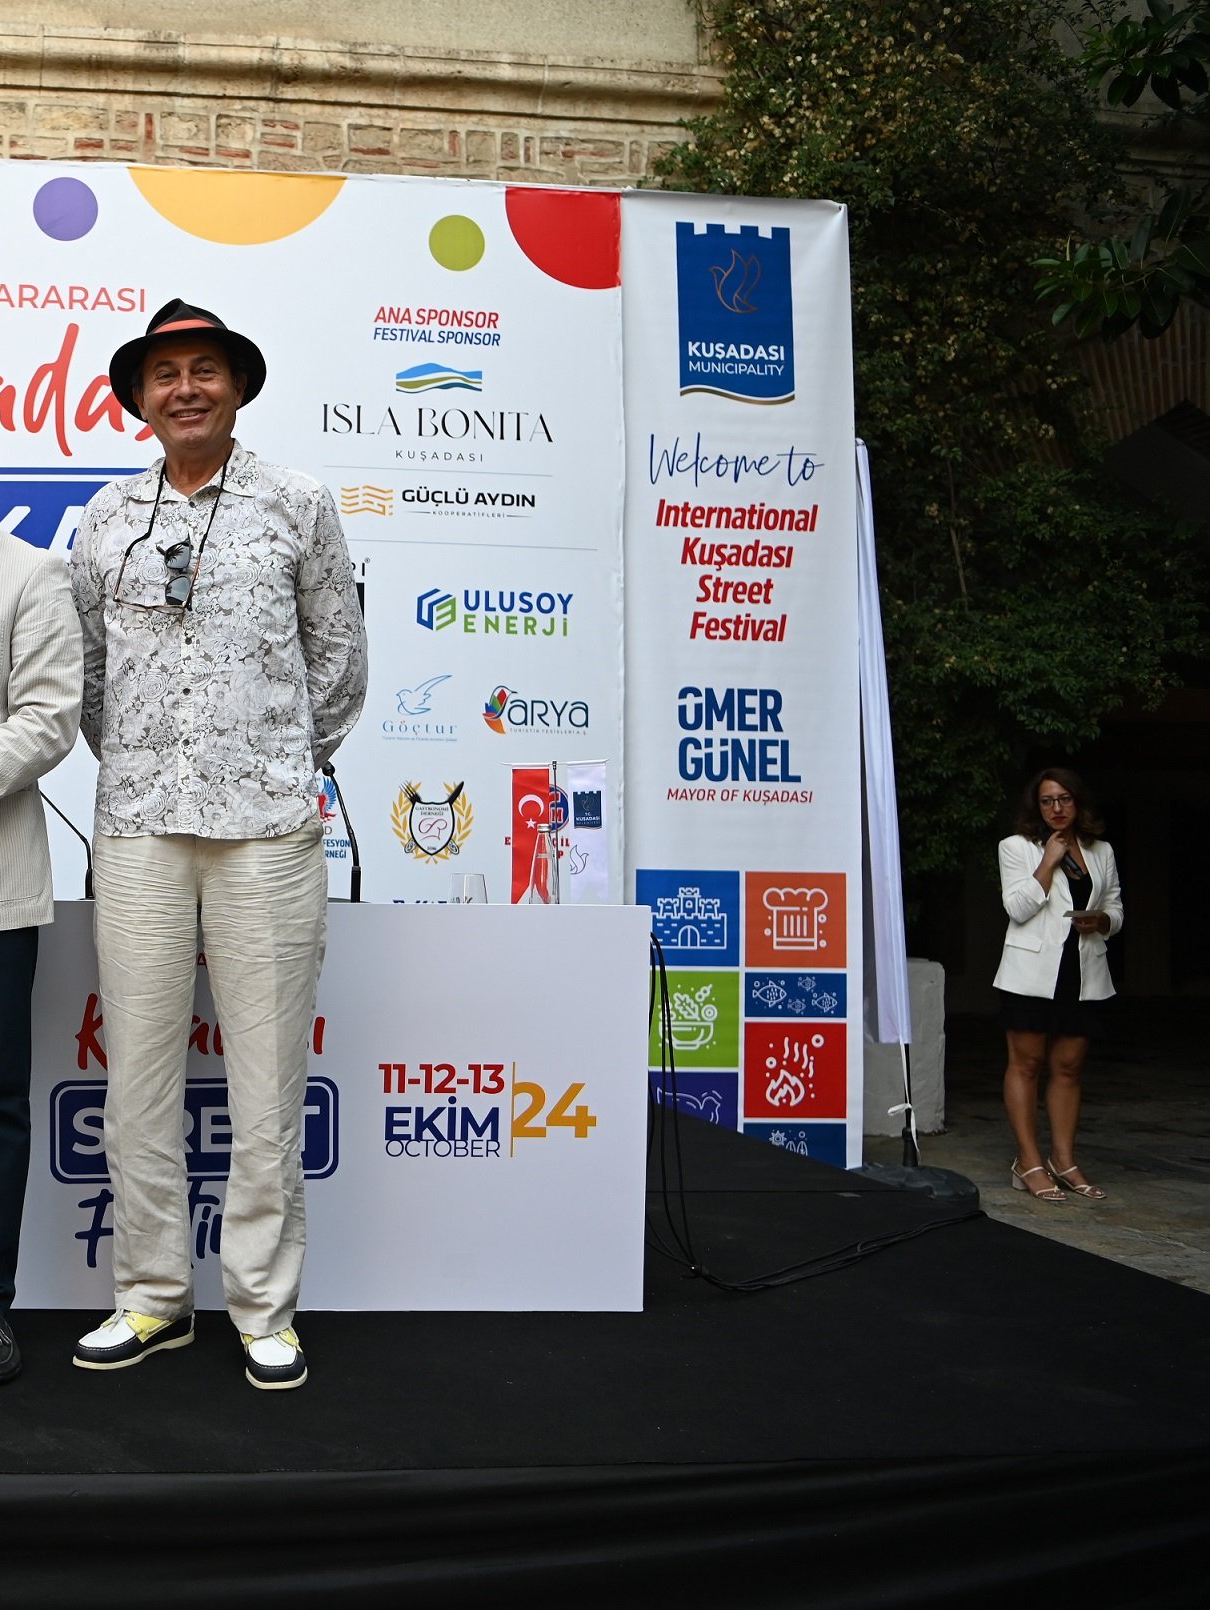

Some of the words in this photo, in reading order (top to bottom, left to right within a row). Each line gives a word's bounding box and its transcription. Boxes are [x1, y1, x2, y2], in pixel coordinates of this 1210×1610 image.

[374, 306, 412, 325] ANA
[414, 308, 500, 329] SPONSOR
[373, 328, 435, 343] FESTIVAL
[436, 330, 501, 347] SPONSOR
[688, 341, 785, 361] KUŞADASI
[689, 360, 785, 376] MUNICIPALITY
[322, 403, 402, 436] ISLA
[417, 407, 553, 443] BONITA
[395, 450, 483, 463] KUŞADASI
[650, 432, 781, 488] Welcome
[776, 445, 825, 487] to
[401, 486, 470, 507] GÜÇLÜ
[474, 493, 536, 508] AYDIN
[656, 498, 819, 532] International
[680, 537, 794, 571] Kuşadası
[463, 588, 574, 615] ULUSOY
[695, 574, 774, 605] Street
[463, 613, 568, 637] ENERJİ
[689, 611, 788, 642] Festival
[678, 736, 802, 783] GÜNEL
[667, 787, 716, 801] MAYOR
[720, 789, 739, 802] OF
[742, 789, 813, 806] KUŞADASI
[378, 1063, 505, 1095] 11-12-13
[384, 1095, 500, 1141] EKİM
[512, 1081, 597, 1138] 24
[385, 1139, 501, 1158] OCTOBER
